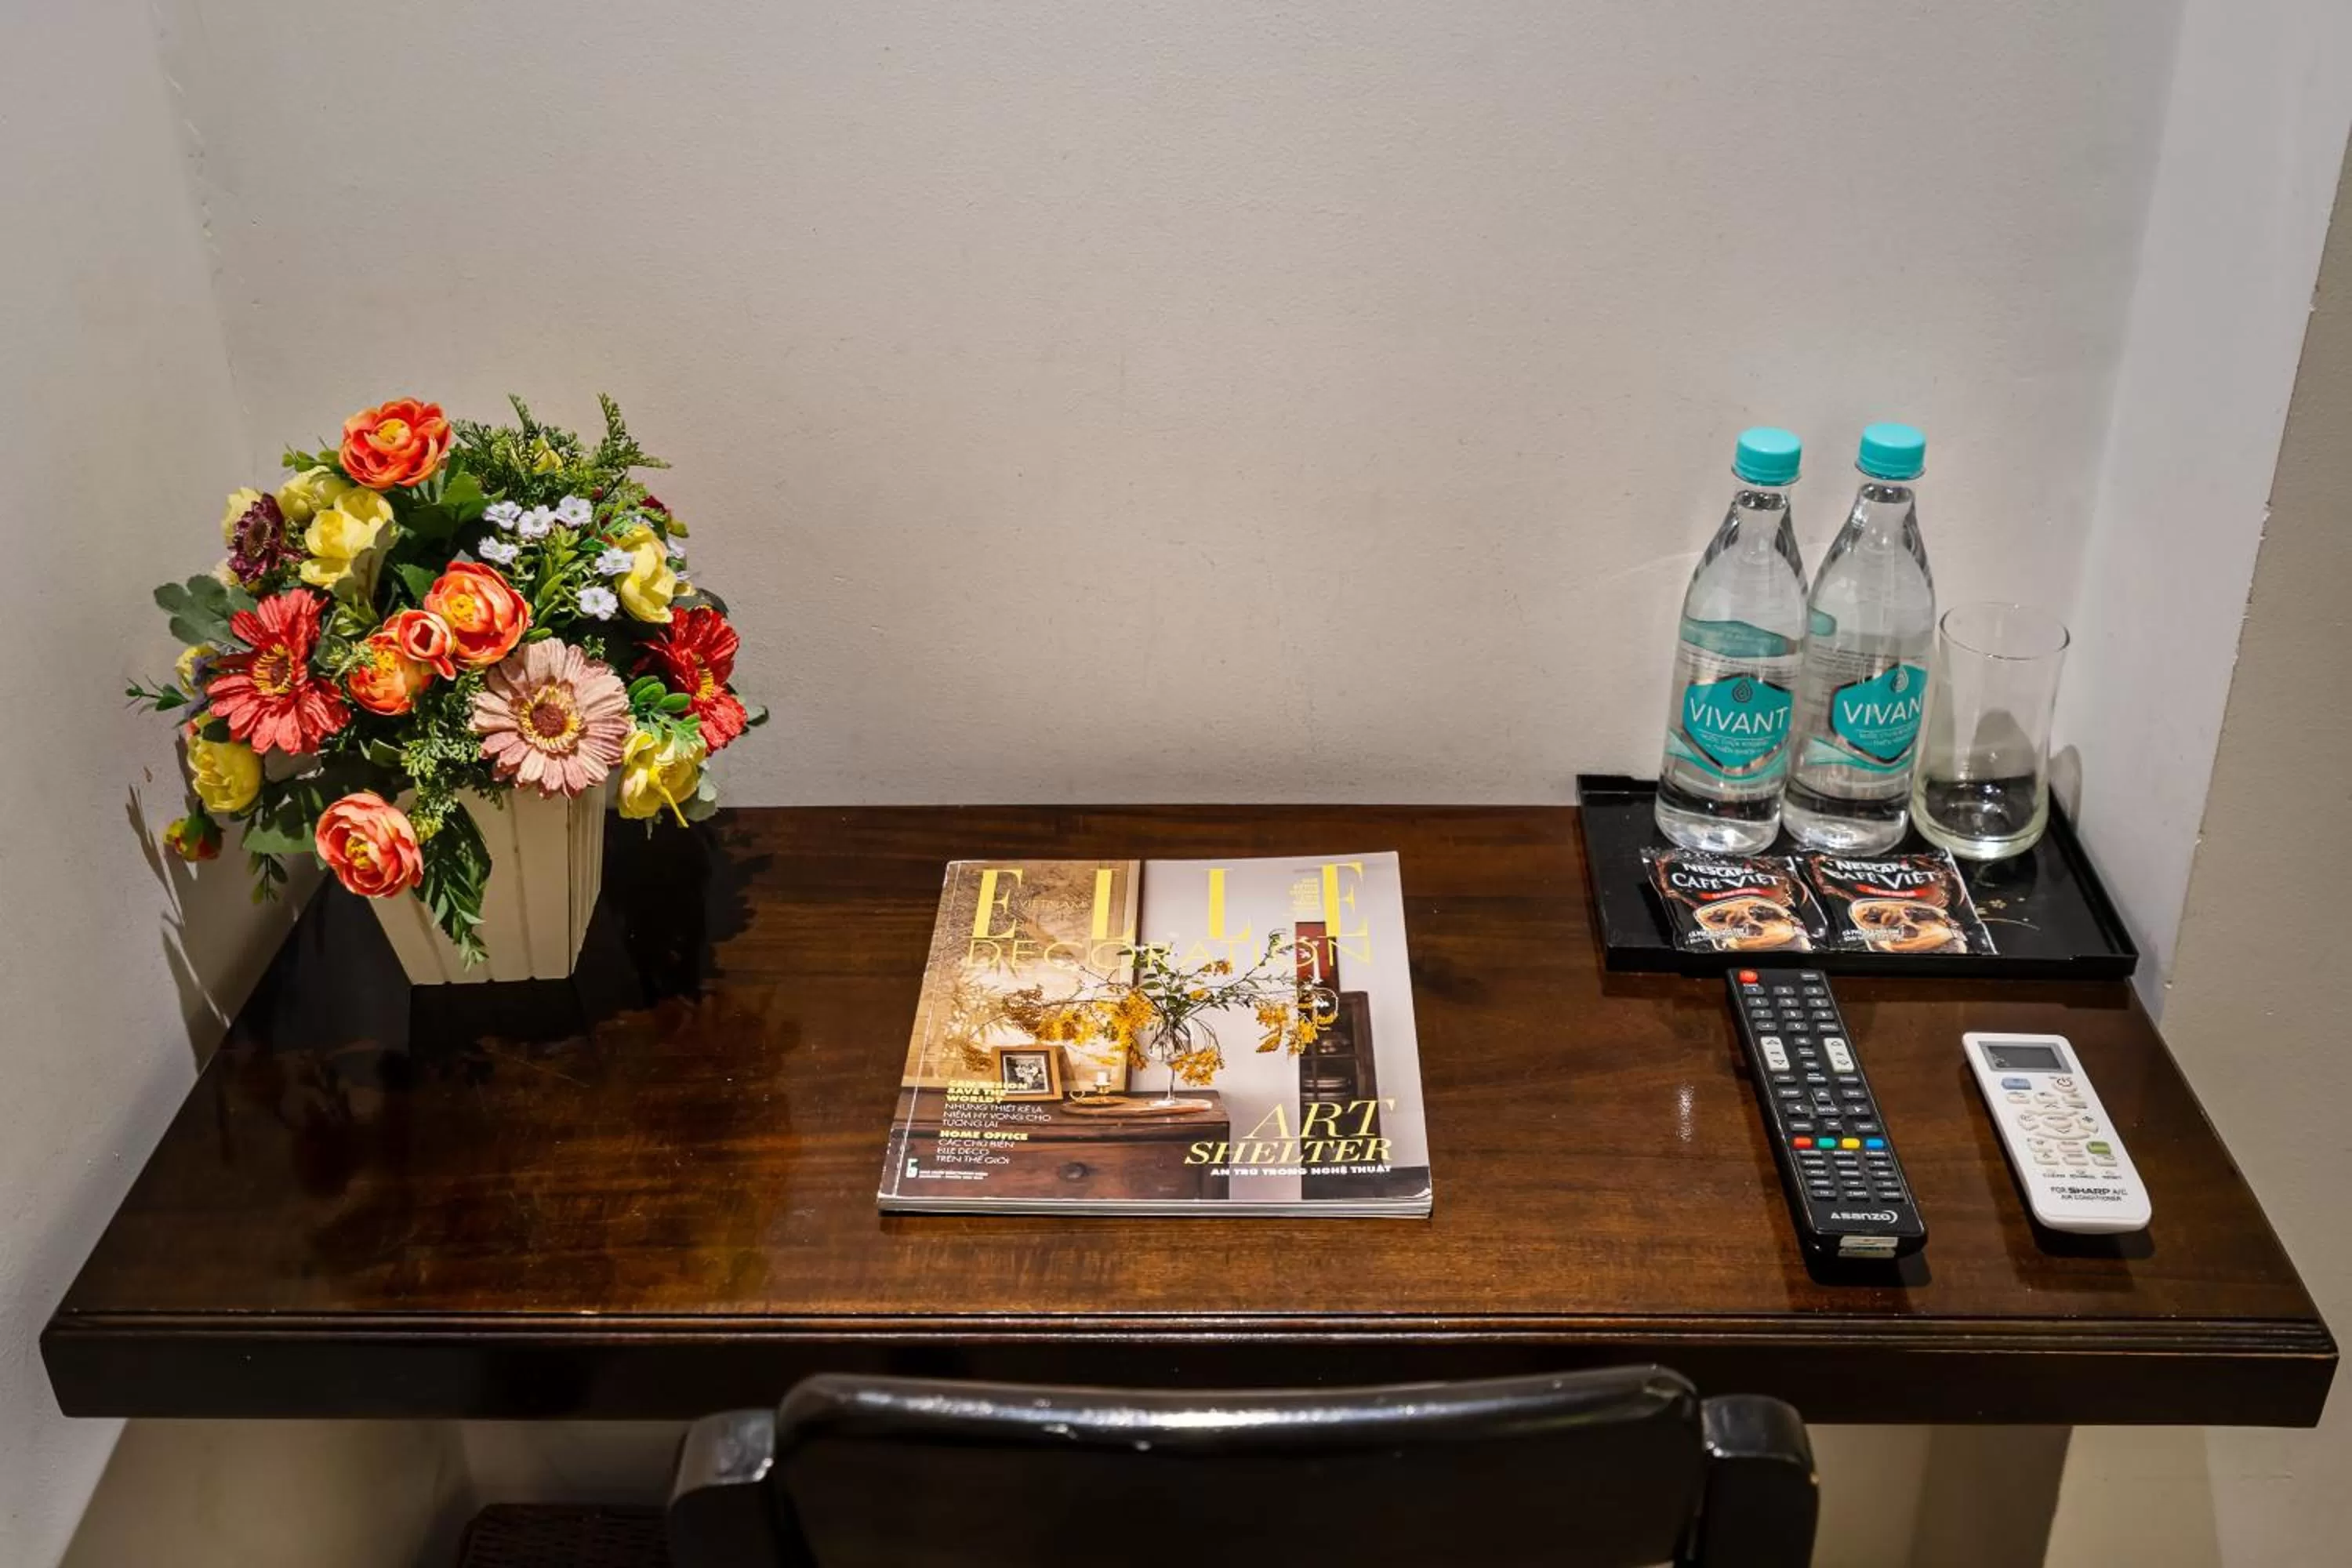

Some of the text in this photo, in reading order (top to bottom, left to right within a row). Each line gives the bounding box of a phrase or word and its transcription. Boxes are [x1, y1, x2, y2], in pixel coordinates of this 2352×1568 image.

[1690, 697, 1789, 735] VIVANT
[967, 862, 1369, 942] ELLE
[967, 938, 1371, 970] DECORATION
[1241, 1099, 1396, 1139] ART
[940, 1130, 1029, 1141] HOME OFFICE
[1184, 1137, 1393, 1165] SHELTER
[1261, 1167, 1308, 1176] TRONG
